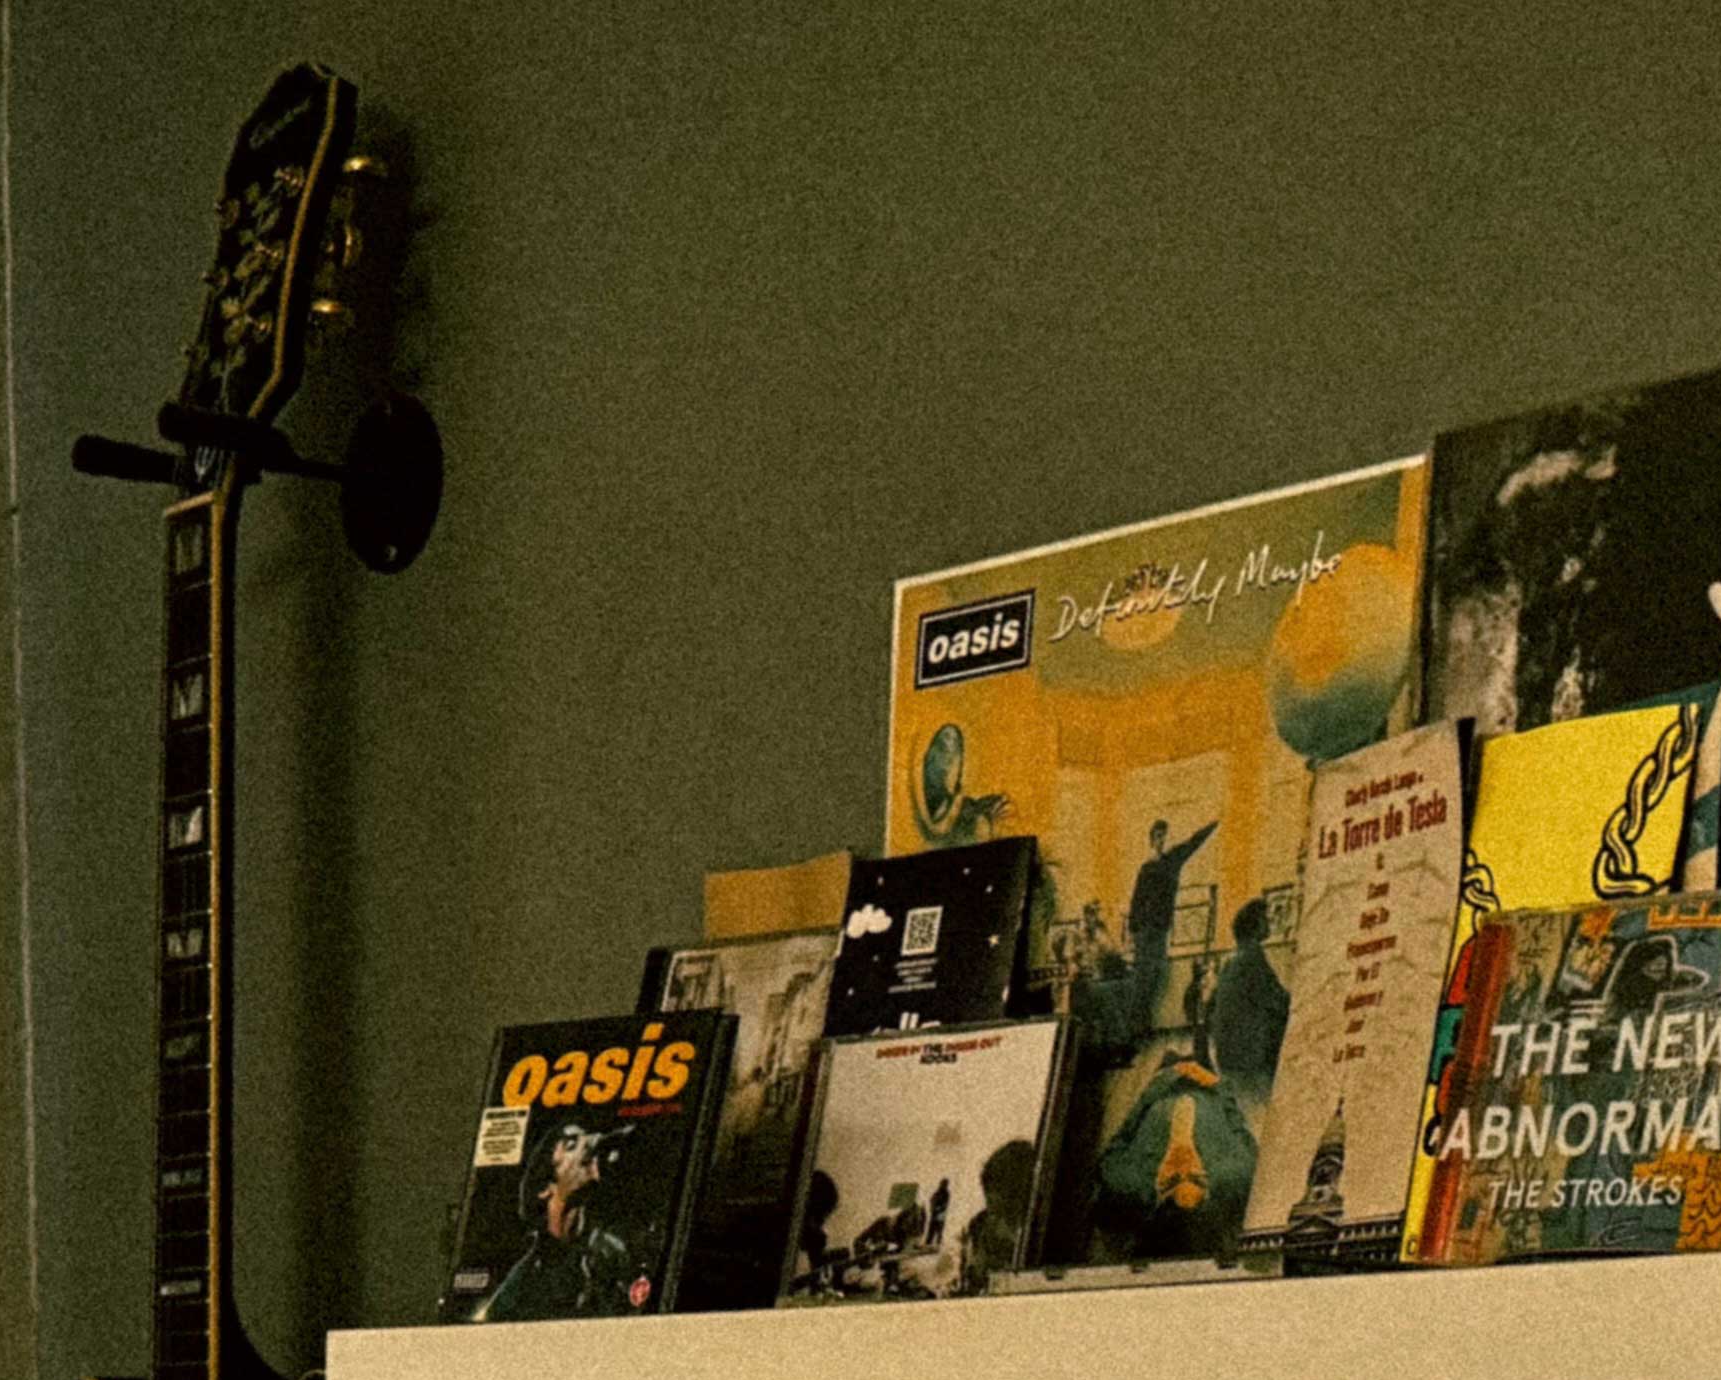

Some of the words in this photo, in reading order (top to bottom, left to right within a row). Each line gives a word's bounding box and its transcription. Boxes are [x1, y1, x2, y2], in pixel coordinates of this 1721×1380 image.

[1049, 557, 1224, 642] Definitely
[1237, 531, 1342, 601] Maybe
[927, 611, 1021, 664] oasis
[1318, 825, 1338, 859] La
[1341, 816, 1381, 854] Torre
[1383, 802, 1404, 841] de
[1407, 788, 1448, 833] Tesla
[502, 1022, 696, 1108] oasis
[1488, 1020, 1591, 1079] THE
[1487, 1178, 1544, 1209] THE
[1550, 1172, 1684, 1209] STROKES
